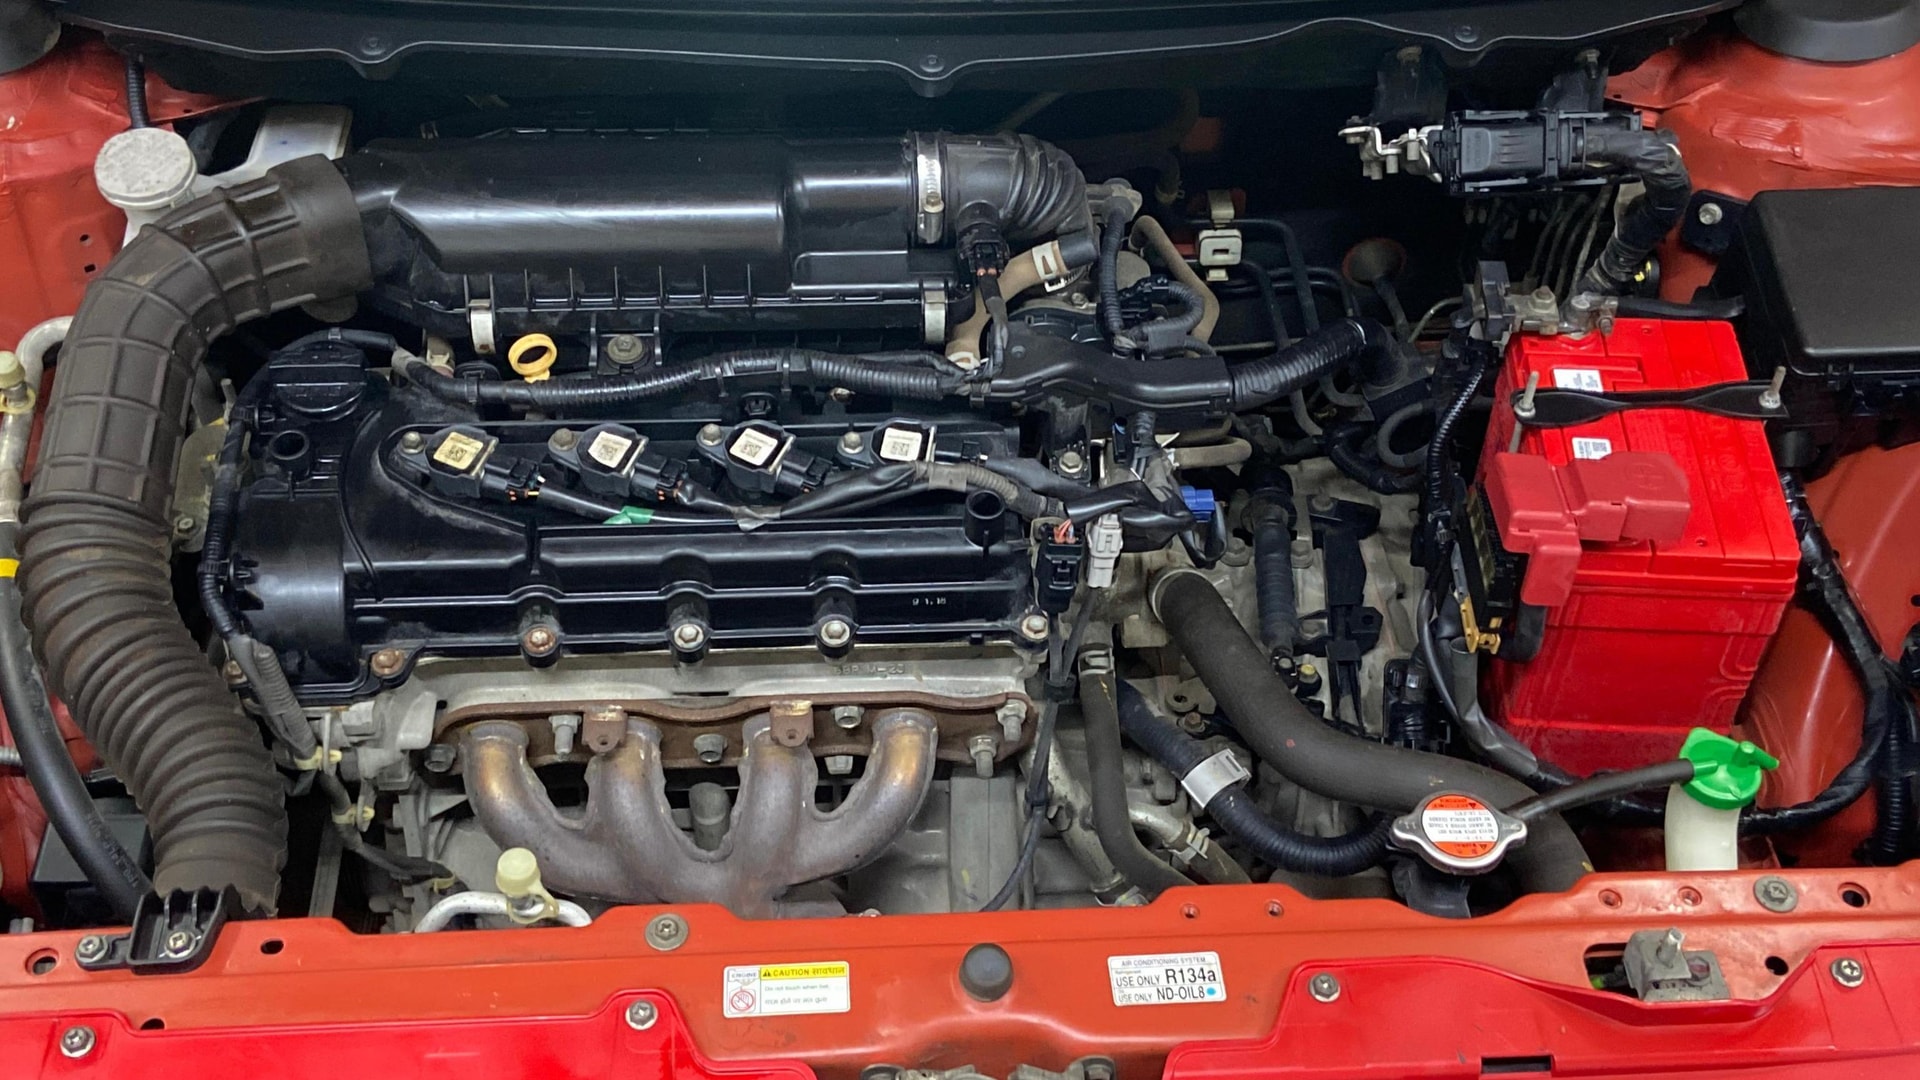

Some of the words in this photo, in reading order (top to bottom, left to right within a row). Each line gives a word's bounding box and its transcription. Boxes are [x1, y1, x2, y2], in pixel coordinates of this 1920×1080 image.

[1134, 958, 1179, 967] CONDITIONING
[1180, 956, 1206, 964] SYSTEM
[773, 968, 810, 977] CAUTION
[1115, 976, 1135, 987] USE
[1137, 974, 1161, 986] ONLY
[1164, 967, 1217, 985] R134a
[1118, 993, 1132, 1003] USE
[1134, 992, 1153, 1002] ONLY
[1156, 986, 1205, 1001] ND-OIL8
